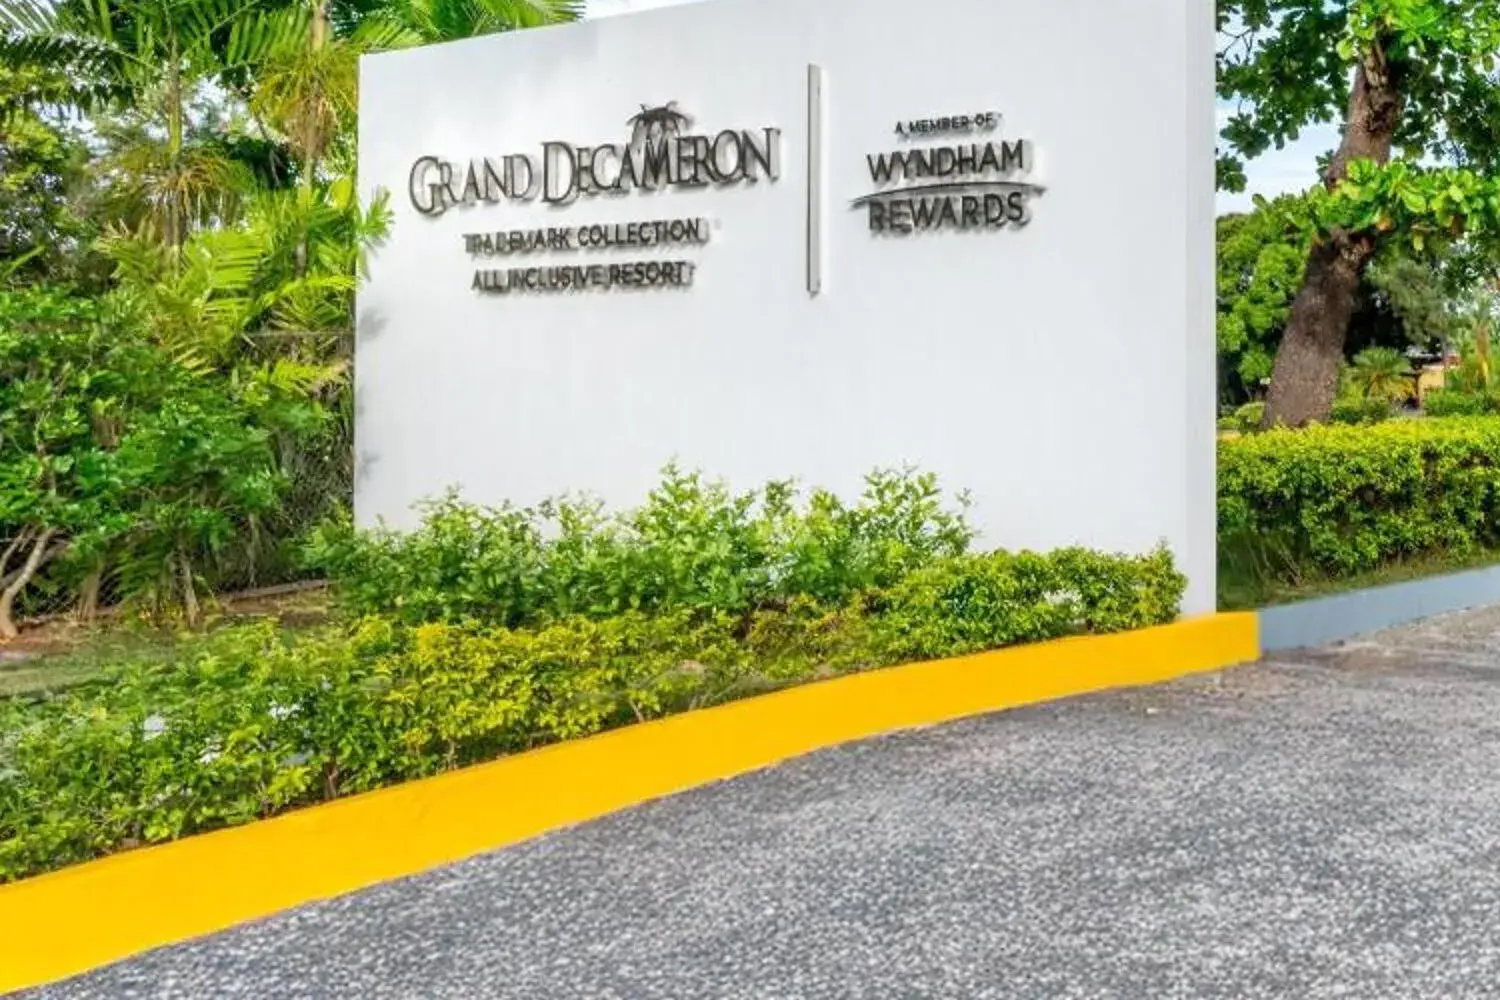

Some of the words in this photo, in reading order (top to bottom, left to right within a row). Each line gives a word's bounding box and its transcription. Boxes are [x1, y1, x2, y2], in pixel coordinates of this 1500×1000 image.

[893, 121, 903, 135] A
[909, 115, 968, 132] MEMBER
[975, 110, 994, 126] OF
[867, 138, 1024, 182] WYNDHAM
[868, 191, 1025, 231] REWARDS
[462, 229, 571, 256] TRADEMARK
[577, 217, 701, 247] COLLECTION
[471, 270, 506, 293] ALL
[508, 264, 604, 291] INCLUSIVE
[608, 259, 687, 286] RESORT
